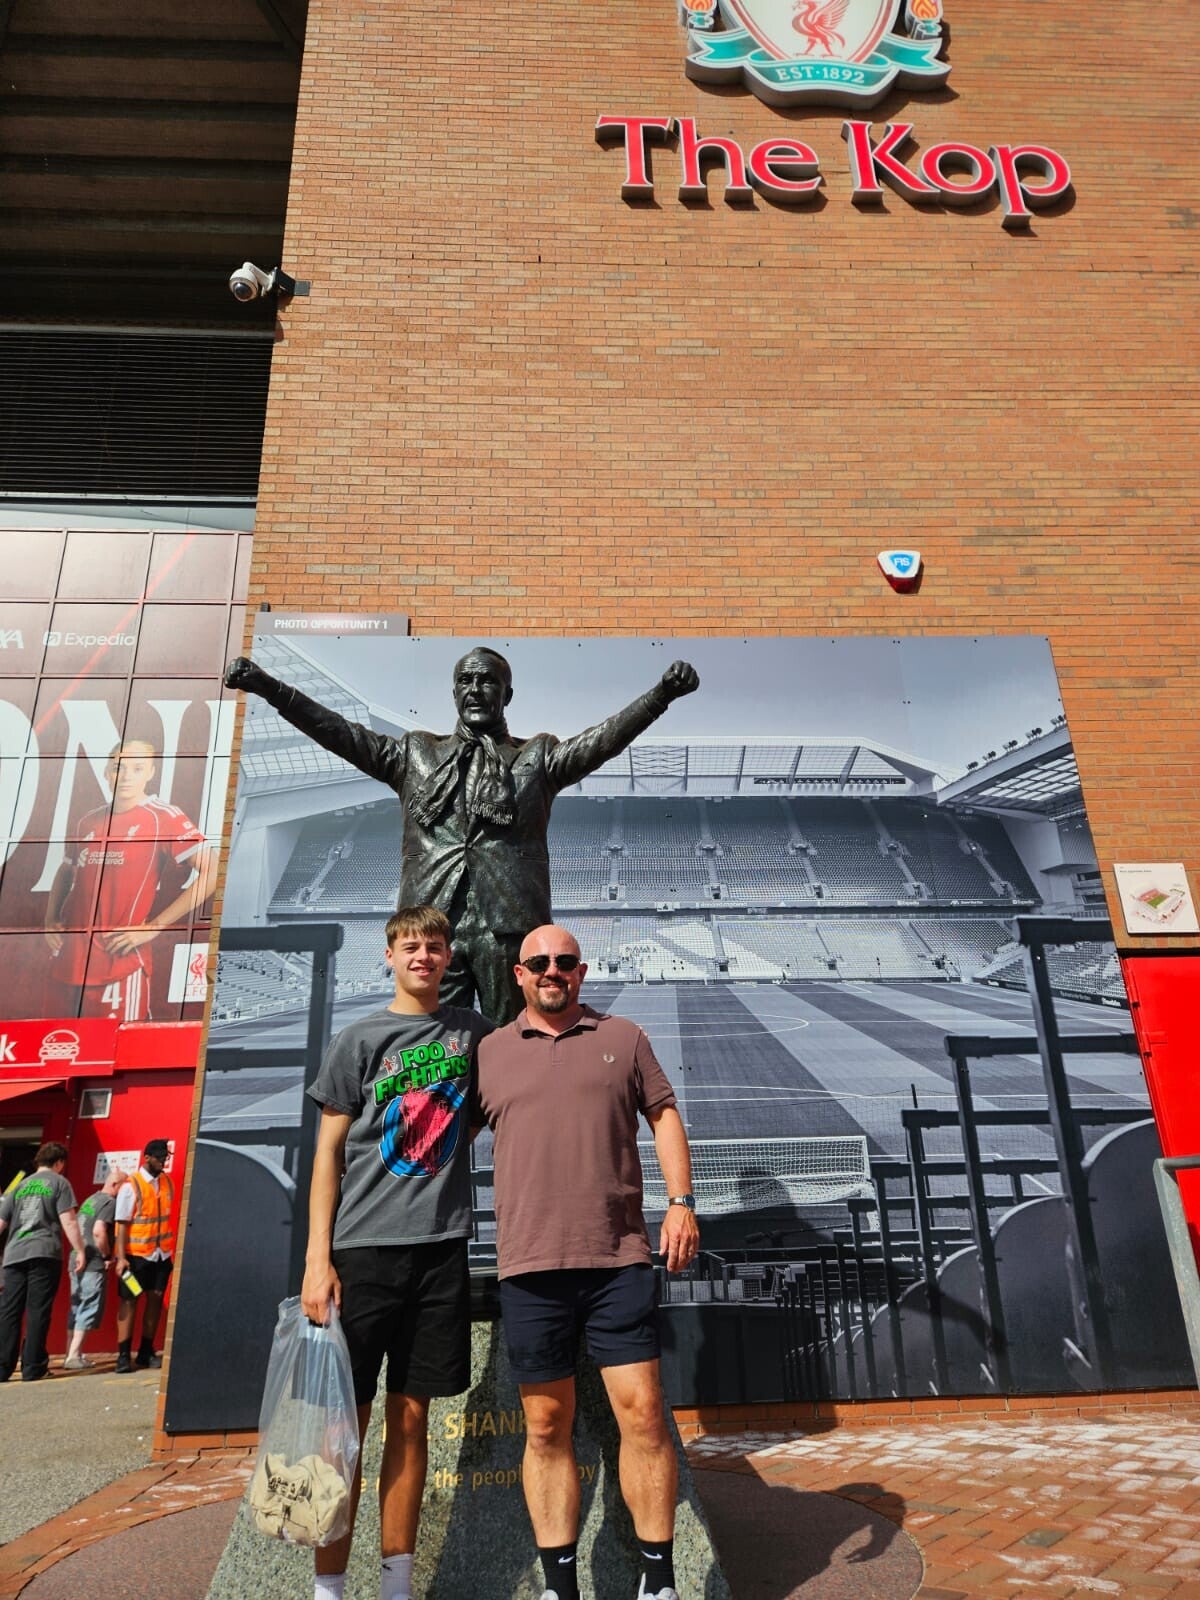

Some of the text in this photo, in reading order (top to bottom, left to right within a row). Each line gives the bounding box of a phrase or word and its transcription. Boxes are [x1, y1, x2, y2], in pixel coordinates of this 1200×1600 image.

[596, 115, 1071, 216] The Kop
[274, 619, 388, 630] PHOTO OPPORTUNITY 1
[101, 981, 122, 1010] 4
[400, 1041, 445, 1069] FOO
[374, 1054, 469, 1105] FIGHTERS
[433, 1467, 463, 1489] the
